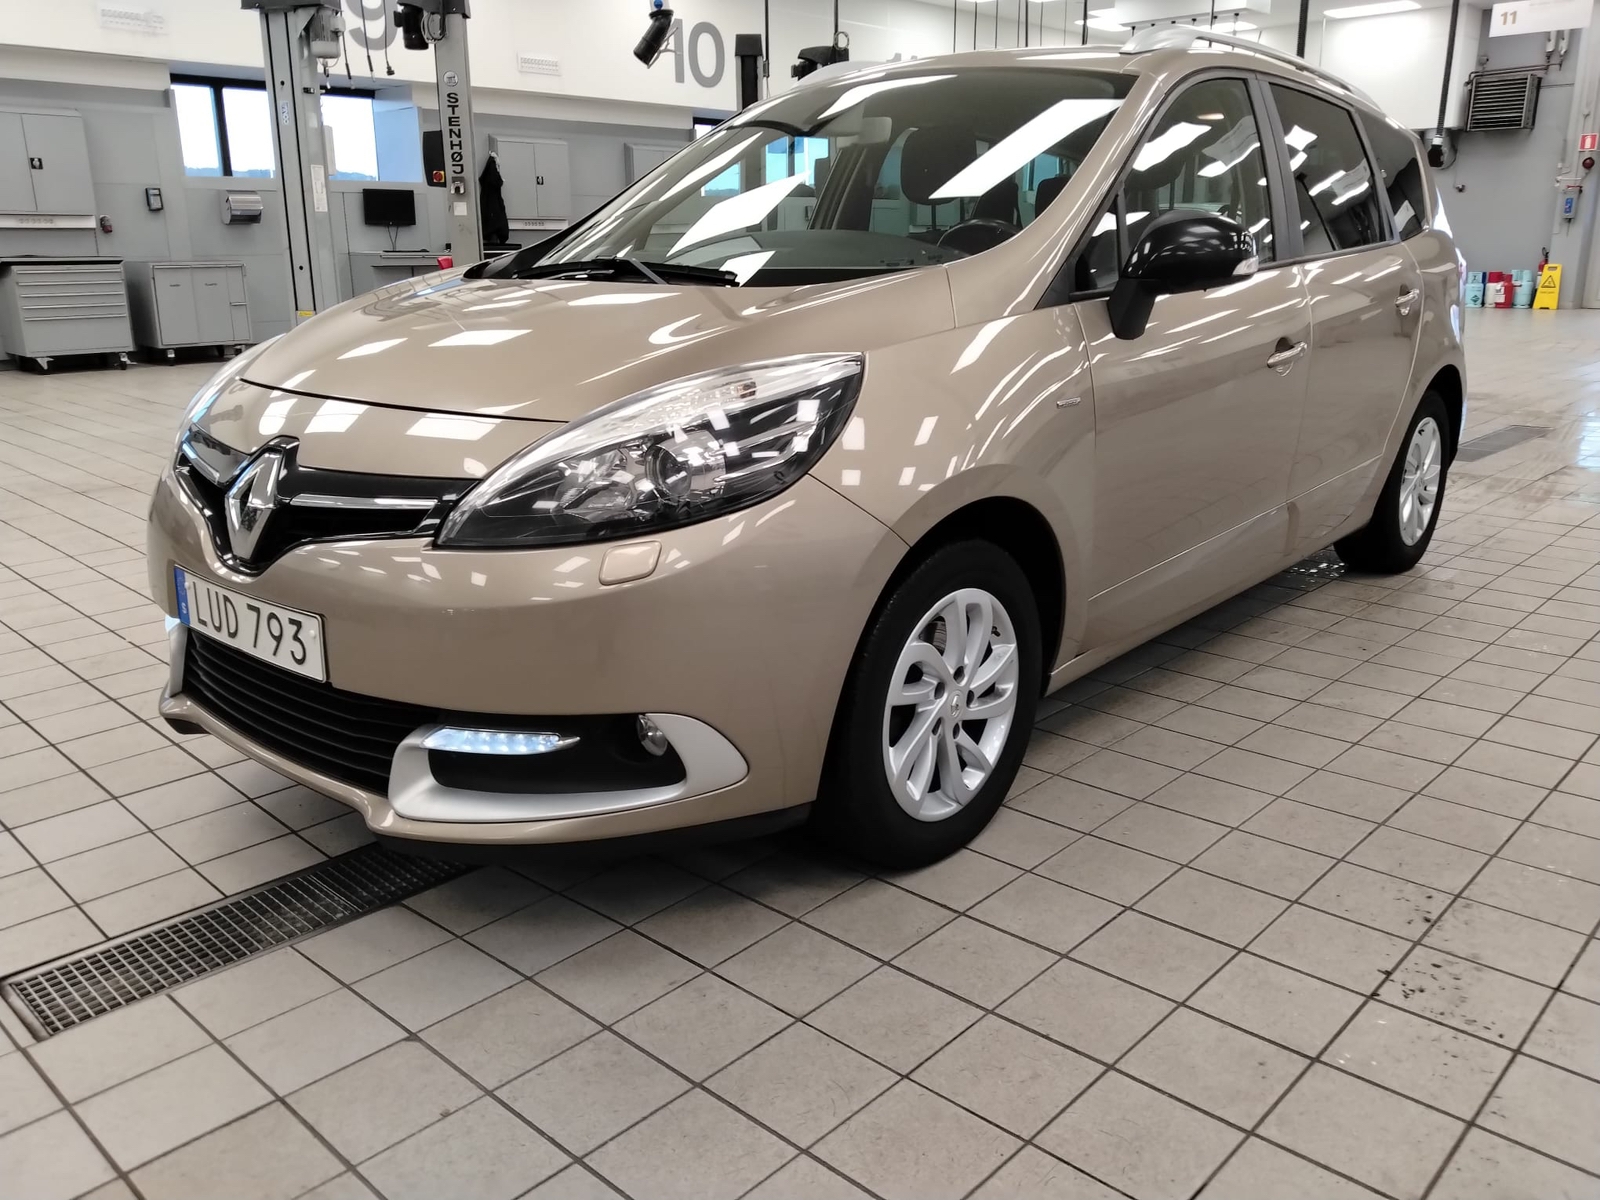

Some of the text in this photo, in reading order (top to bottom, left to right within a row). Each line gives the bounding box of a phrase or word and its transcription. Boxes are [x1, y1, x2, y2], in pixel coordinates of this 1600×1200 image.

[665, 17, 725, 88] 10
[1500, 10, 1517, 26] 11
[446, 92, 464, 175] STENHØJ
[192, 581, 307, 666] LUD 793
